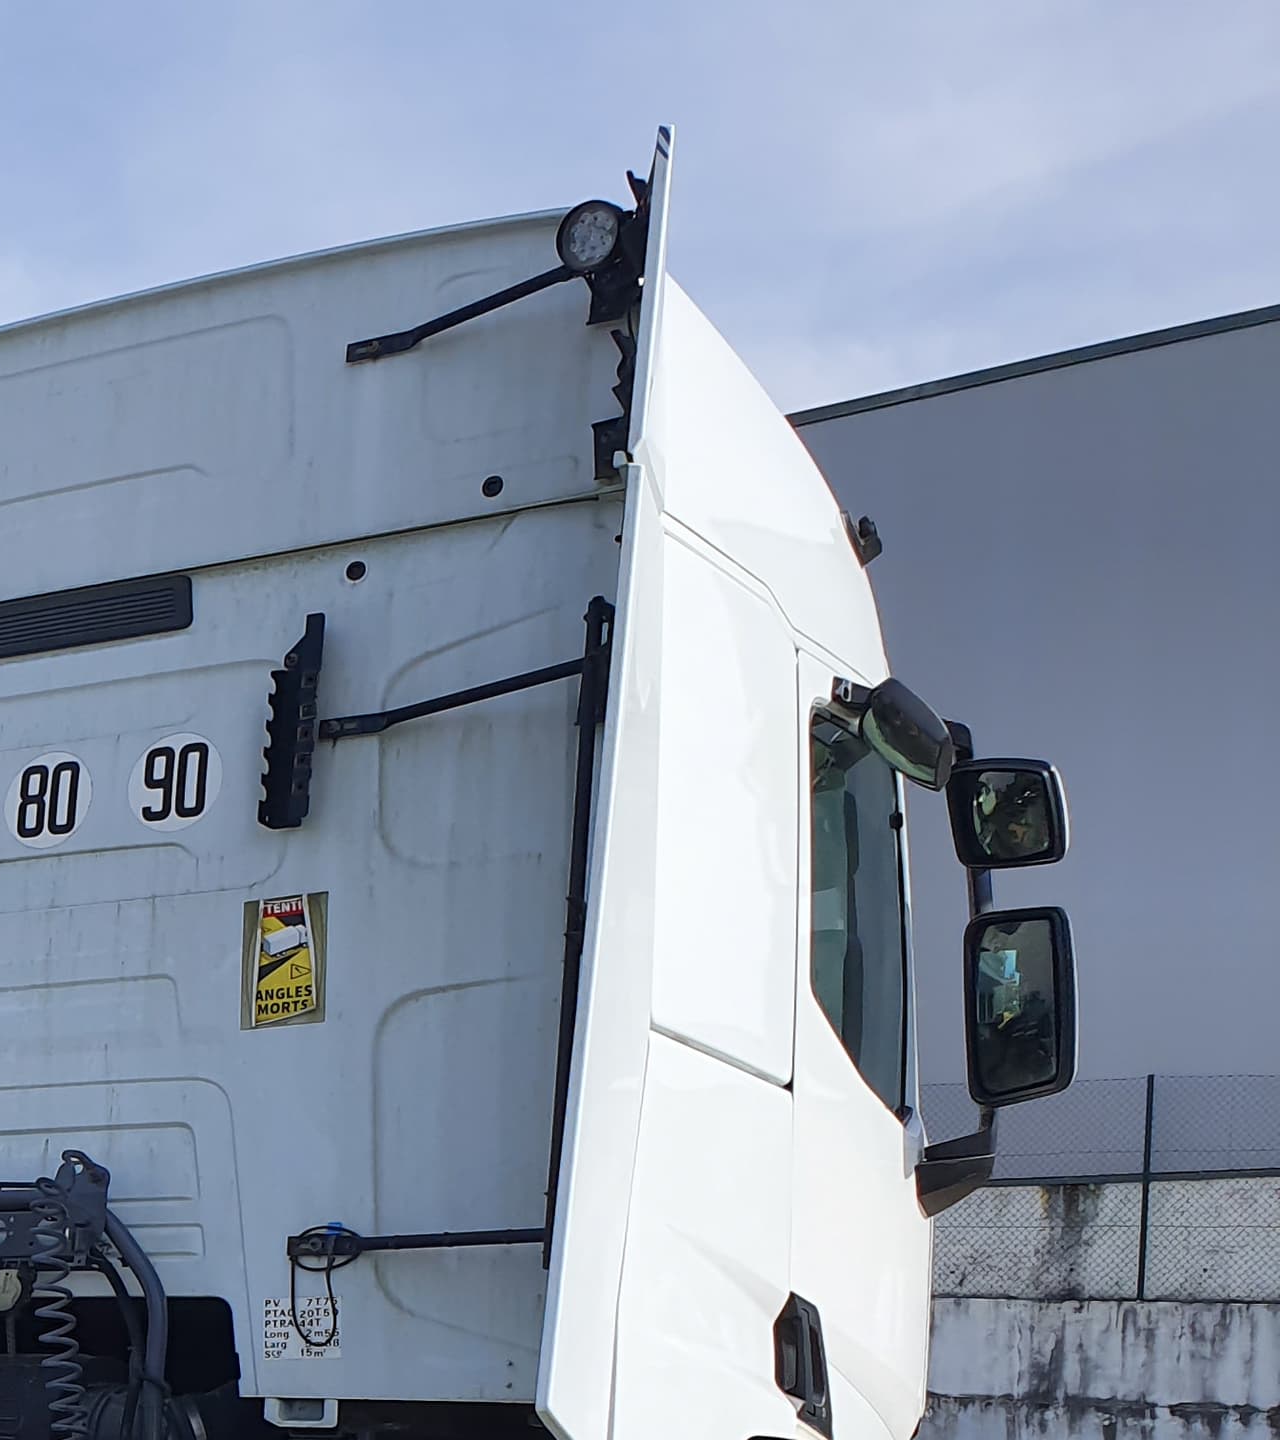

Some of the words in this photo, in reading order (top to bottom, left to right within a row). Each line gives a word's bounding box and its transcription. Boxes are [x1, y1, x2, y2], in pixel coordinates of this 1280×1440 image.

[142, 742, 209, 822] 90
[17, 761, 80, 838] 80
[264, 900, 302, 915] TENTI
[256, 985, 312, 1001] ANGLES
[257, 999, 308, 1015] MORTS
[265, 1330, 289, 1340] Long
[265, 1340, 287, 1350] Larg
